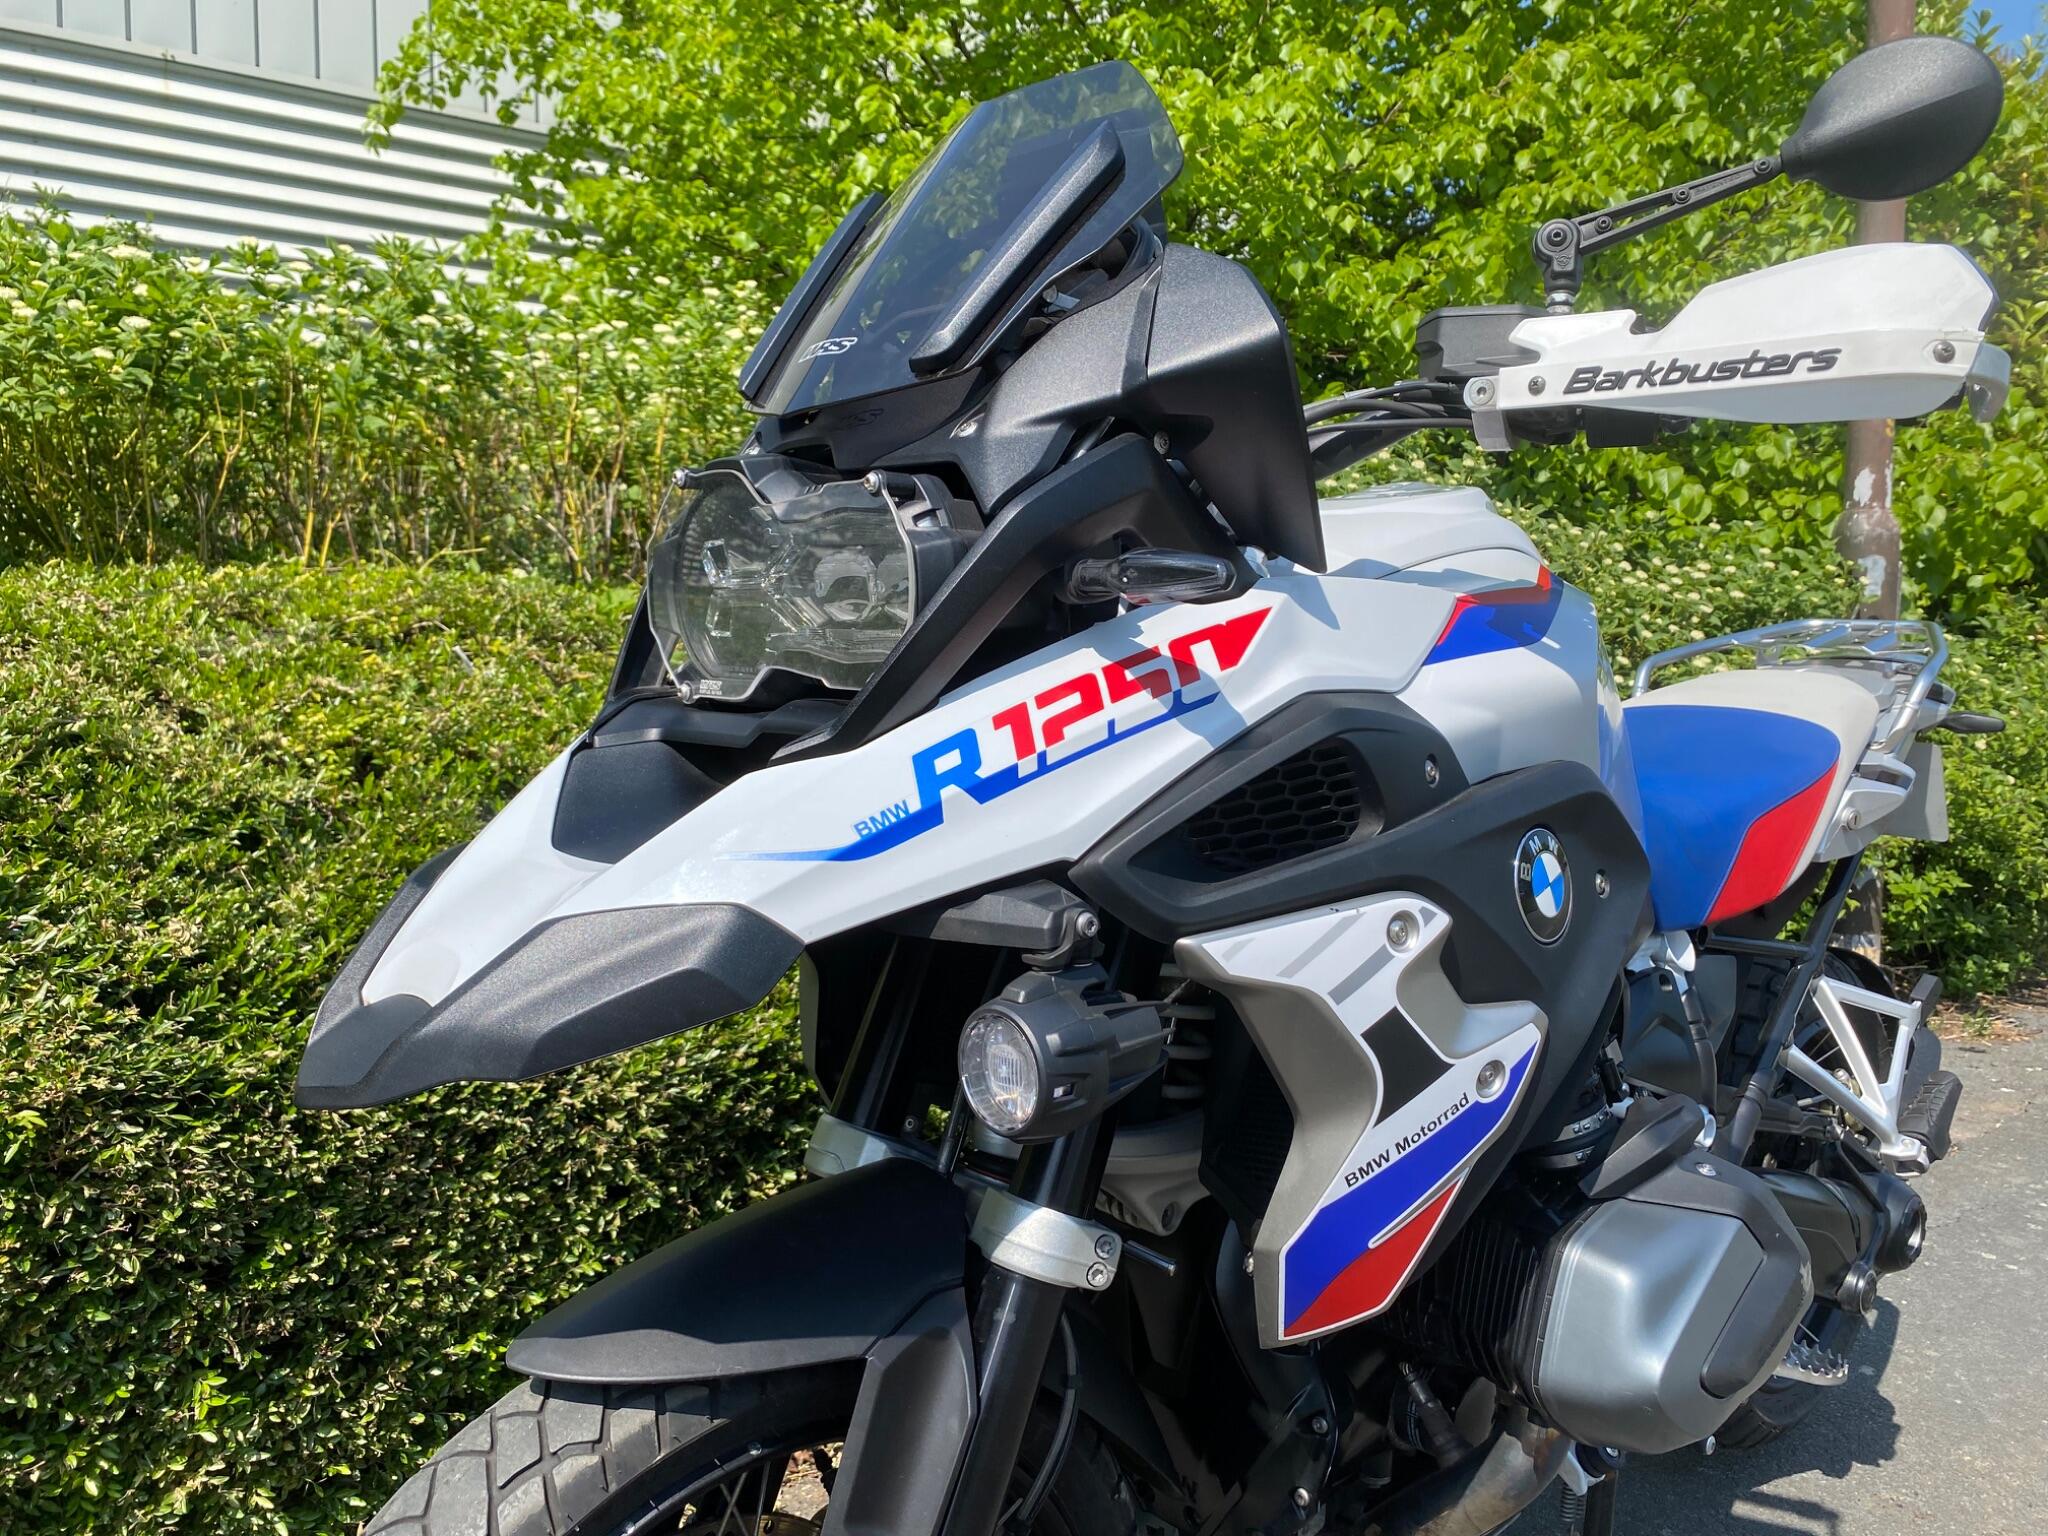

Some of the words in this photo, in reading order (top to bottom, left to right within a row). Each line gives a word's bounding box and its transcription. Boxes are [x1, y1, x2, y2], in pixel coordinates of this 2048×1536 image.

[1563, 348, 1842, 394] Barkbusters
[853, 799, 911, 839] BMW
[1520, 835, 1559, 882] BMW
[1344, 1149, 1391, 1188] BMW
[1394, 1092, 1470, 1155] Motorrad
